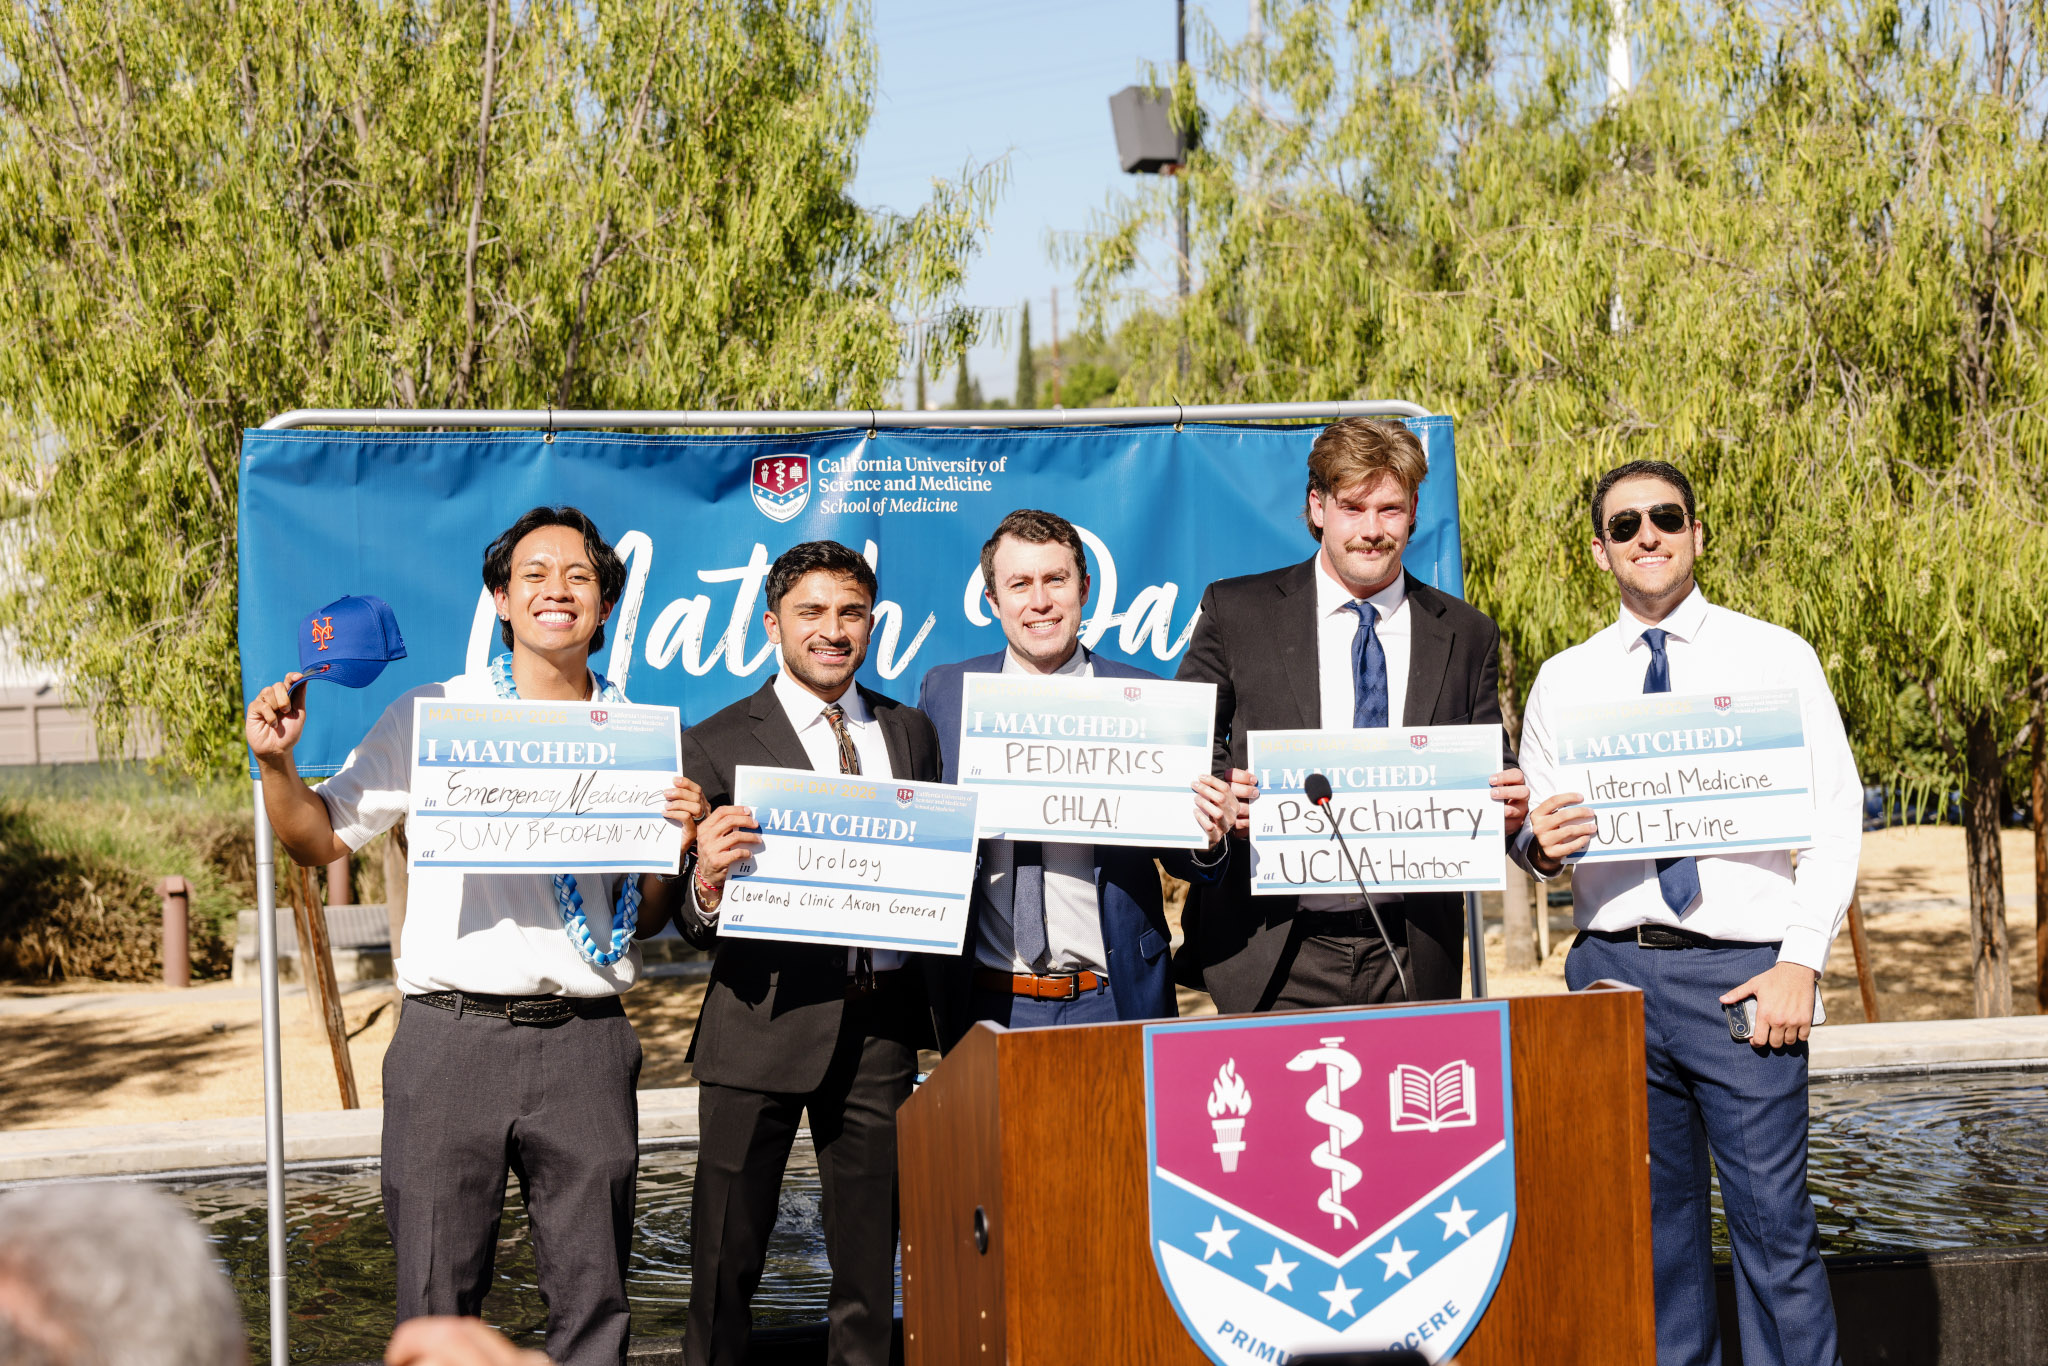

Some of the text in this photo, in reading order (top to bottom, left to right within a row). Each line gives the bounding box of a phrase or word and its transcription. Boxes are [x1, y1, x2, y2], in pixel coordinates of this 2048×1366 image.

[818, 456, 1008, 476] California University of
[818, 476, 992, 493] Science and Medicine
[820, 497, 958, 516] School of Medicine
[465, 530, 936, 694] Math
[428, 707, 568, 723] MATCH DAY 2026
[973, 711, 1147, 738] I MATCHED!
[426, 739, 617, 765] I MATCHED!
[1564, 726, 1742, 760] I MATCHED!
[971, 766, 982, 776] in
[1006, 742, 1165, 775] PEDIATRICS
[750, 776, 877, 799] MATCH DAY 2026
[1261, 765, 1436, 790] I MTCHED!
[1587, 767, 1772, 800] Internal Medicine
[424, 797, 437, 808] in
[447, 769, 667, 820] Emergency Medicine
[1043, 794, 1121, 829] CHLA!
[1278, 796, 1483, 840] Psychiatry
[436, 820, 519, 852] SUNY
[765, 808, 917, 842] MATCHED!
[1262, 824, 1273, 833] in
[1594, 809, 1739, 845] UCI-Irvine
[422, 849, 435, 858] at
[798, 845, 882, 881] Urology
[740, 863, 751, 872] in
[1263, 871, 1275, 880] at
[730, 885, 946, 921] Cleveland Clinic Akron General
[731, 913, 744, 922] at
[1217, 1319, 1294, 1366] PRIMU
